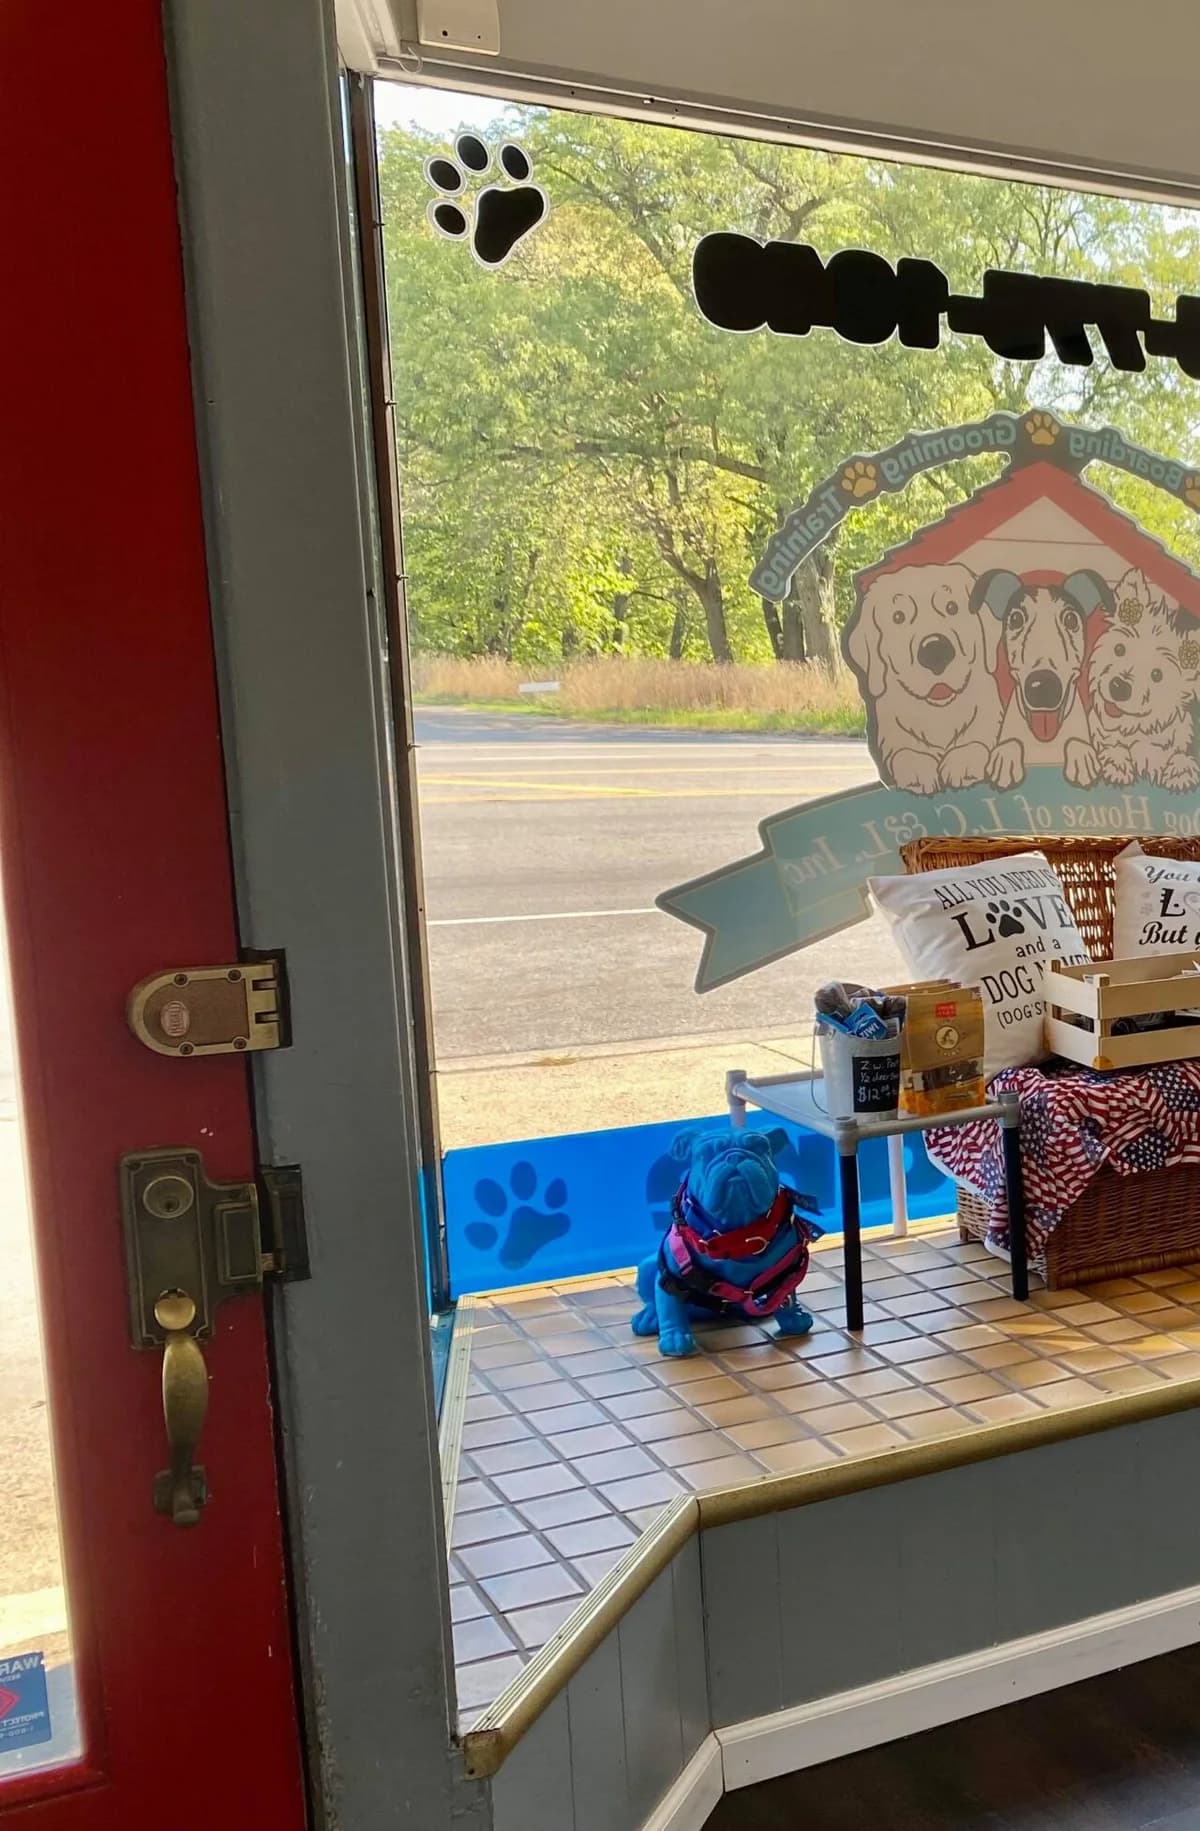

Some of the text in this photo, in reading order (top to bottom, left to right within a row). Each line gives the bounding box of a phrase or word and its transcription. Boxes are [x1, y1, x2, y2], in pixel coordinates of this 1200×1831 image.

[1144, 865, 1191, 884] You
[934, 883, 975, 910] ALL
[965, 875, 1007, 898] YOU
[1001, 869, 1046, 893] NEED
[1139, 920, 1188, 945] But
[1015, 936, 1062, 958] and a
[981, 965, 1036, 1004] DOG
